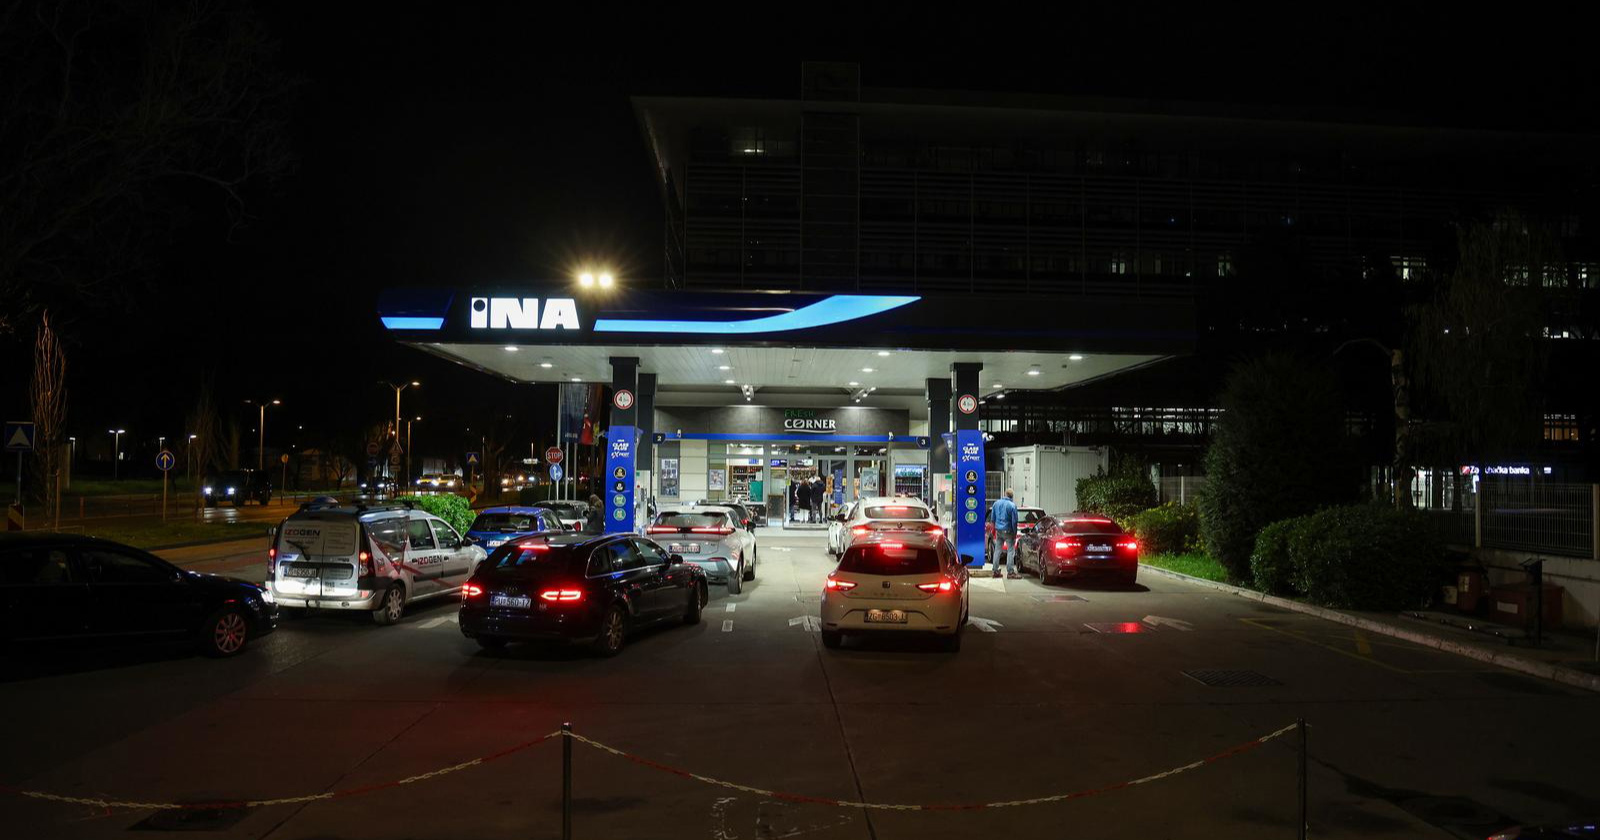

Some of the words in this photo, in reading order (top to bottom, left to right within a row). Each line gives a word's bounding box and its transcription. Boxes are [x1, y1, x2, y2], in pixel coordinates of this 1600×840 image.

[784, 419, 836, 429] CORNER
[1509, 466, 1530, 474] banka
[285, 528, 320, 536] IZOGEN
[417, 555, 442, 565] IZOGEN
